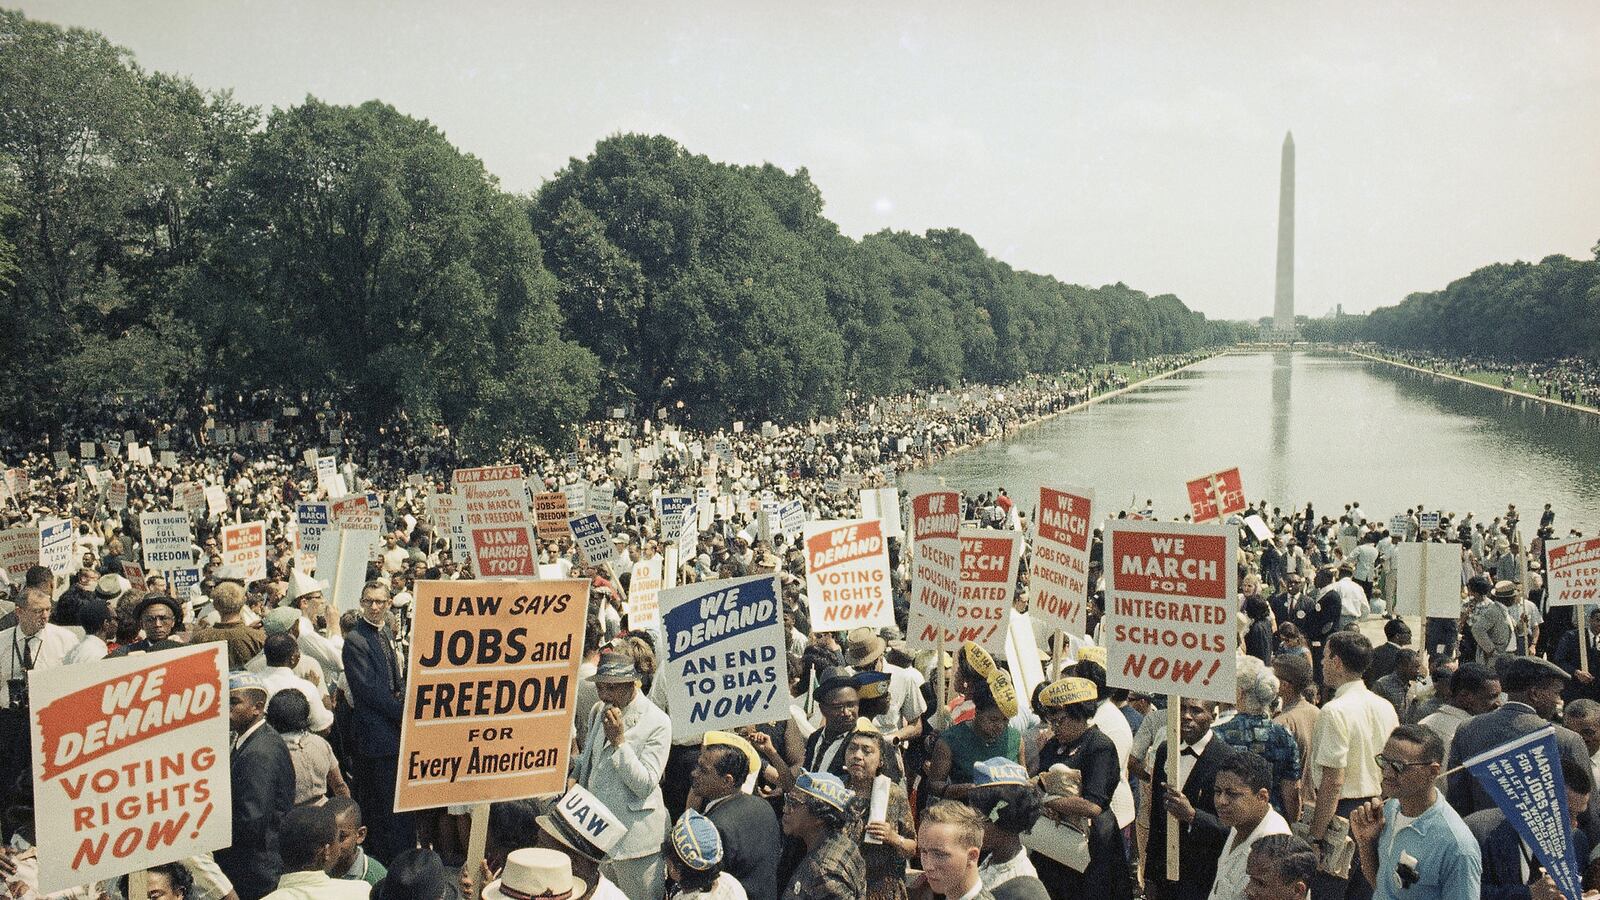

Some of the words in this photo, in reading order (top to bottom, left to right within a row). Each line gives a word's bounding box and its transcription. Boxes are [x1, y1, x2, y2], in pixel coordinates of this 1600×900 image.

[458, 471, 480, 482] UAW
[466, 502, 484, 511] MEN
[488, 500, 520, 510] MARCH
[536, 502, 556, 510] JOBS
[929, 496, 946, 514] WE
[1058, 494, 1073, 512] WE
[467, 514, 482, 524] FOR
[484, 512, 524, 522] FREEDOM
[538, 512, 566, 520] FREEDOM
[918, 513, 958, 536] DEMAND
[1042, 508, 1086, 536] MARCH
[484, 530, 517, 544] UAW
[574, 522, 600, 534] MARCH
[830, 526, 858, 546] WE
[1054, 530, 1072, 544] FOR
[146, 536, 188, 544] EMPLOYMENT
[229, 534, 260, 546] MARCH
[584, 535, 606, 548] JOBS
[1150, 537, 1185, 556] WE
[148, 552, 190, 561] FREEDOM
[230, 552, 260, 563] JOBS
[480, 545, 528, 558] MARCHES
[590, 549, 612, 562] NOW!
[814, 536, 881, 567] DEMAND
[922, 544, 955, 570] DECENT
[1035, 545, 1055, 560] JOBS
[1056, 552, 1070, 568] FOR
[1072, 559, 1084, 574] ALL
[490, 560, 526, 574] TOO!
[961, 555, 1006, 572] RCH
[1121, 555, 1217, 581] MARCH
[1554, 570, 1572, 578] AN
[1576, 568, 1600, 576] FEP
[818, 570, 884, 586] VOTING
[918, 564, 958, 595] HOUSING
[960, 571, 980, 580] OR
[1033, 564, 1039, 577] A
[1040, 566, 1068, 588] DECENT
[1070, 578, 1084, 594] PAY
[1150, 579, 1187, 593] FOR
[1566, 579, 1597, 588] LAW
[700, 588, 740, 620] WE
[823, 586, 882, 602] RIGHTS
[920, 586, 956, 617] NOW!
[960, 586, 1006, 601] RATED
[1559, 588, 1600, 600] NOW
[433, 597, 502, 617] UAW
[509, 594, 572, 615] SAYS
[824, 600, 884, 622] NOW!
[958, 606, 1003, 620] OOLS
[1036, 589, 1080, 624] NOW!
[1114, 598, 1227, 625] INTEGRATED
[674, 600, 774, 654] DEMAND
[418, 628, 528, 668] JOBS
[531, 634, 572, 662] and
[1114, 625, 1226, 654] SCHOOLS
[682, 656, 718, 677] AN
[726, 645, 776, 669] END
[1122, 653, 1222, 686] NOW!
[100, 667, 168, 716] WE
[686, 677, 716, 697] TO
[723, 666, 776, 690] BIAS
[414, 675, 568, 720] FREEDOM
[690, 684, 778, 724] NOW!
[54, 683, 217, 768] DEMAND
[468, 727, 514, 742] FOR
[60, 747, 216, 800] VOTING
[408, 751, 462, 782] Every
[466, 746, 558, 774] American
[74, 778, 211, 832] RIGHTS
[1486, 762, 1502, 777] WE
[1498, 775, 1520, 800] WANT
[1515, 802, 1550, 855] FREEDOM
[1500, 759, 1515, 774] AND
[1510, 774, 1524, 790] LET
[1520, 790, 1532, 806] THE
[1530, 806, 1550, 838] WORLD
[1515, 753, 1532, 774] FOR
[1524, 775, 1548, 810] JOBS
[1546, 816, 1564, 859] FREEDOM
[1529, 745, 1554, 790] MARCH
[1550, 798, 1566, 850] WASHINGTON
[566, 793, 610, 838] UAW
[71, 803, 214, 870] NOW!
